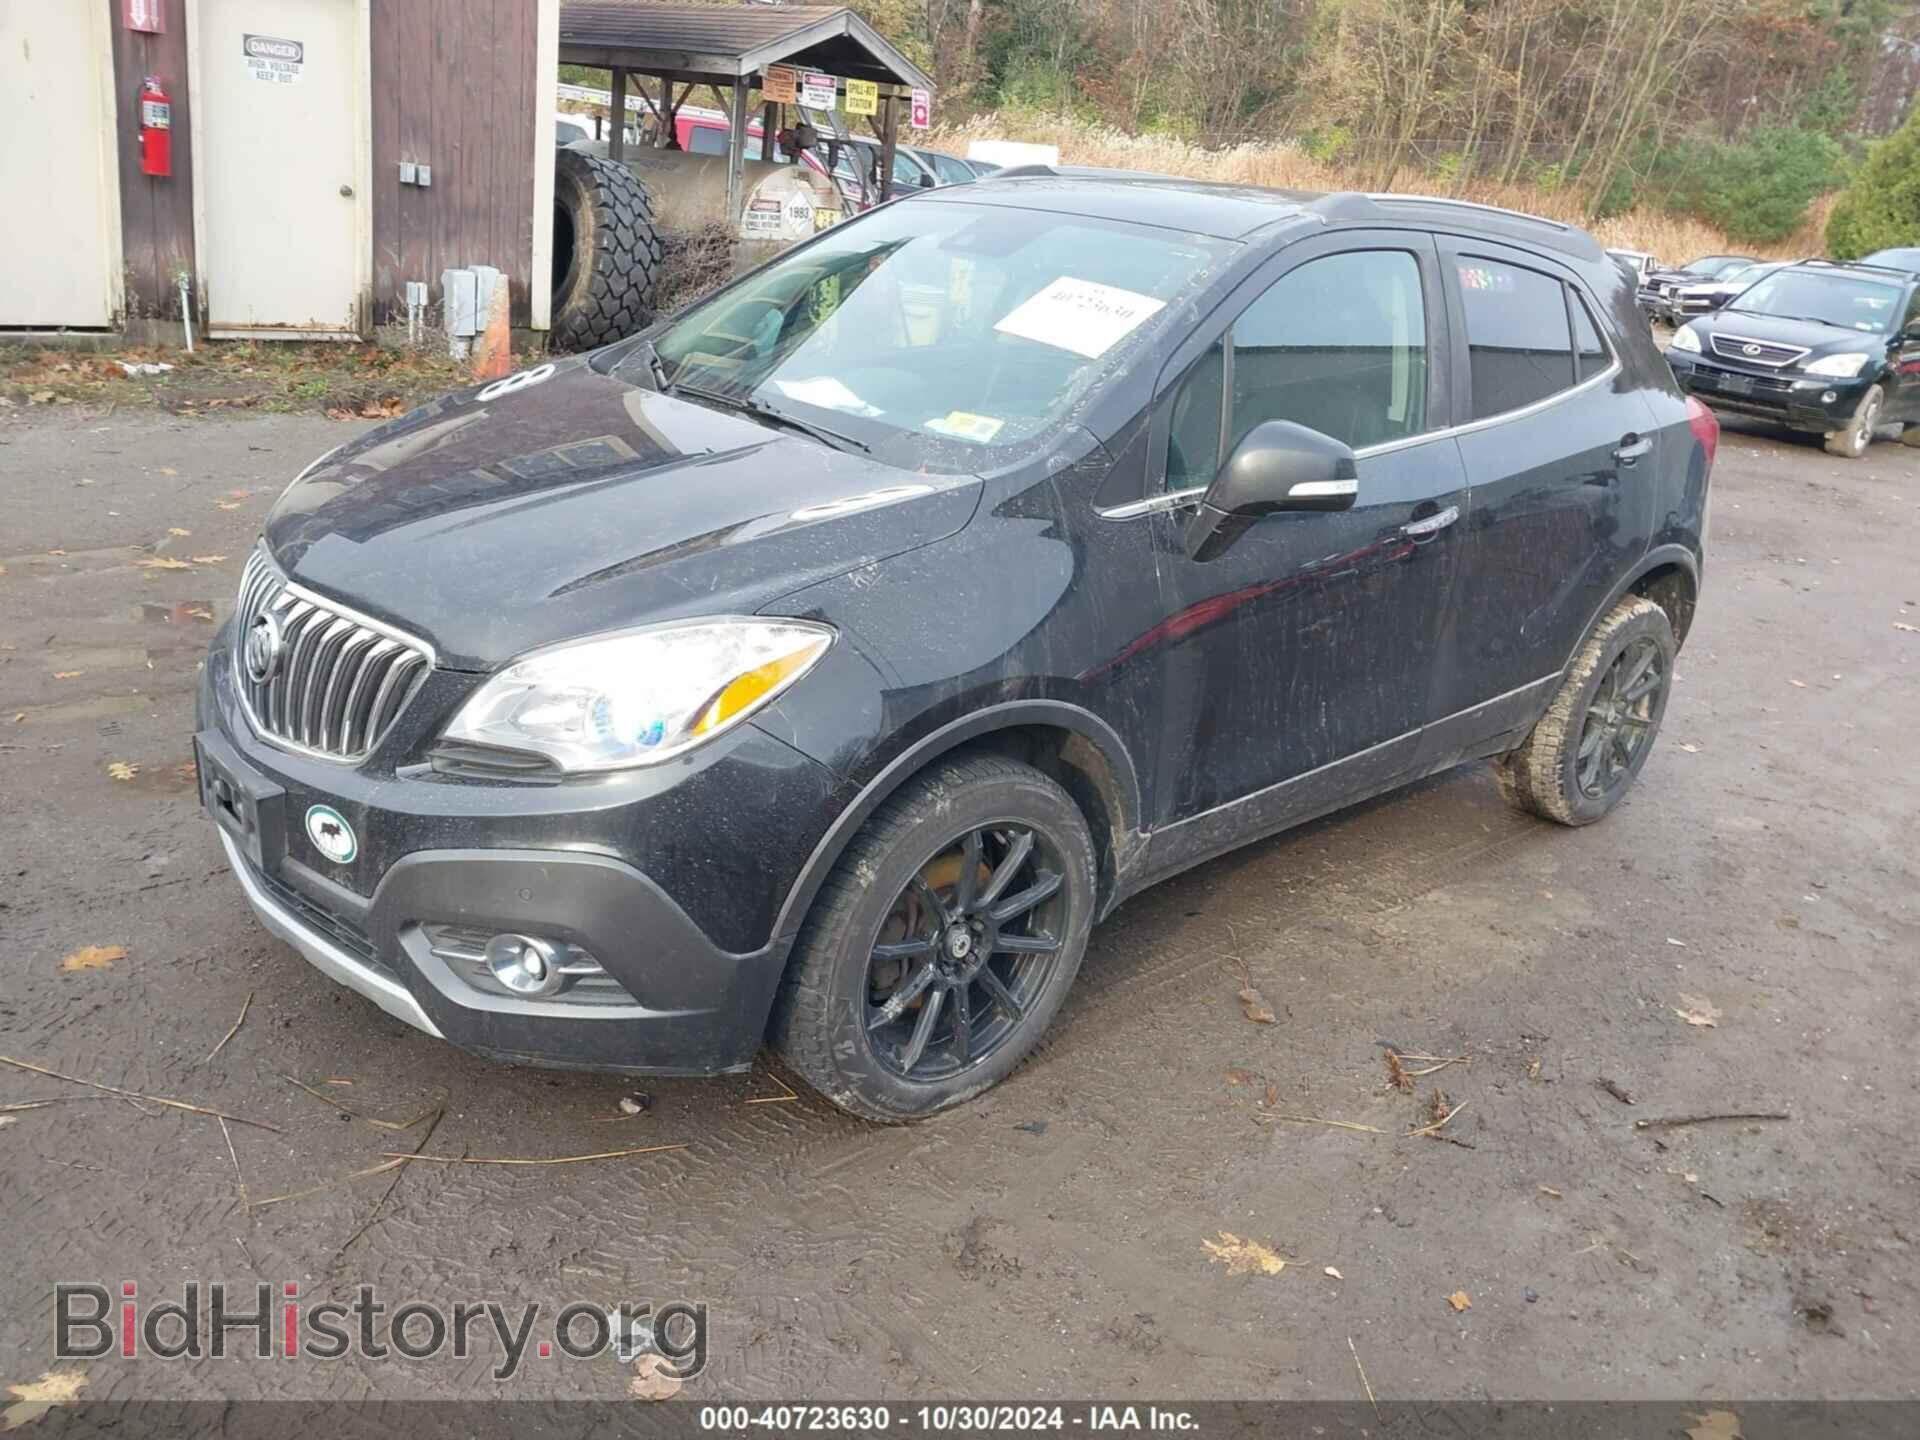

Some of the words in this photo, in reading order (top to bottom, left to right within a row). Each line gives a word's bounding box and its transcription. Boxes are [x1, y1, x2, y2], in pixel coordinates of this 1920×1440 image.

[250, 41, 297, 57] DANGER
[256, 71, 274, 81] KEEP
[849, 97, 873, 110] STATION
